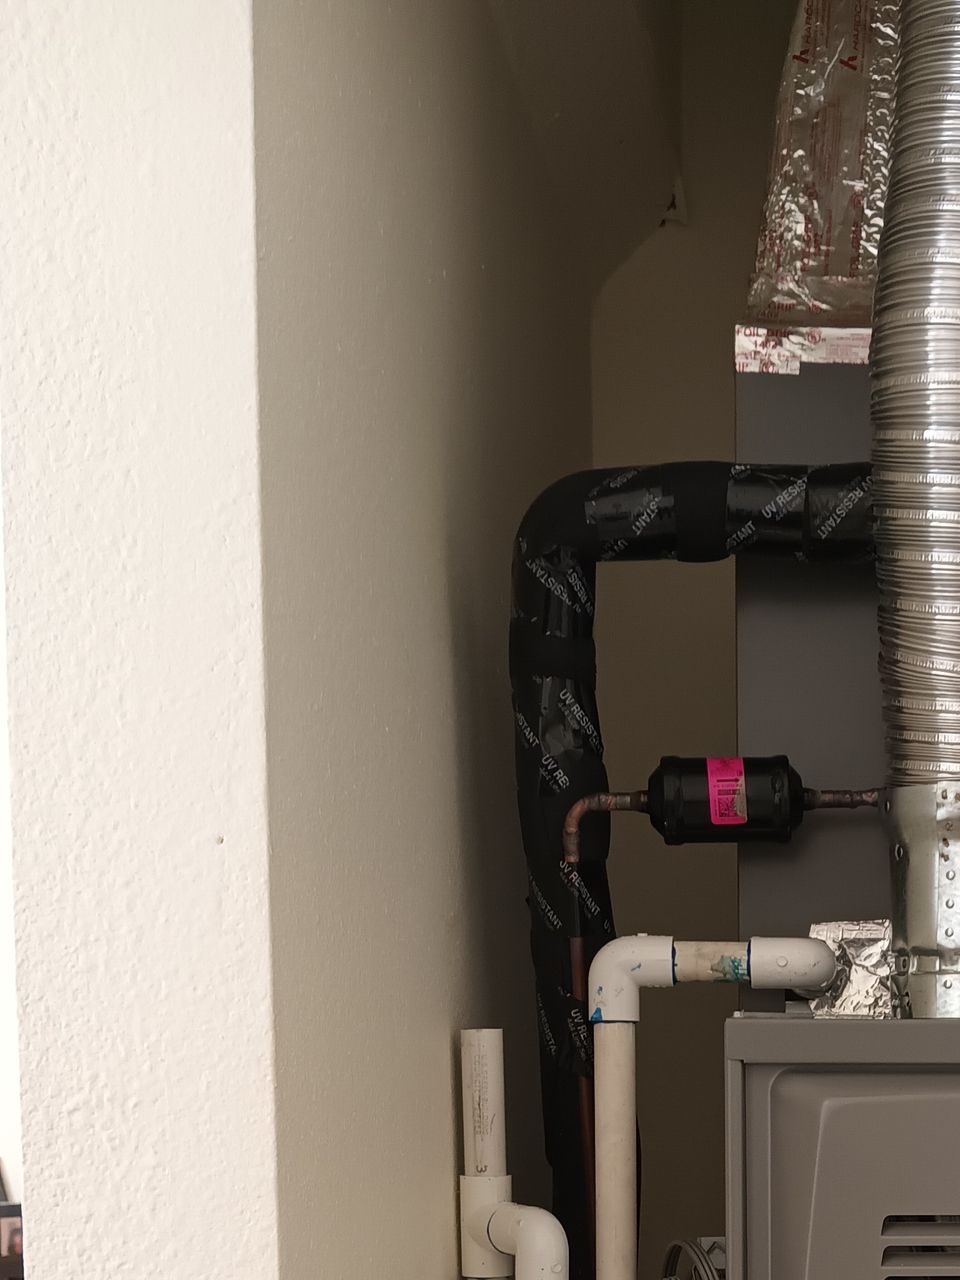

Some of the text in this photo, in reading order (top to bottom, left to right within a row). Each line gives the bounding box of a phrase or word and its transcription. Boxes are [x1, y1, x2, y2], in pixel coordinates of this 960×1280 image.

[761, 501, 777, 520] UV
[560, 688, 575, 706] UV
[541, 754, 558, 771] UV
